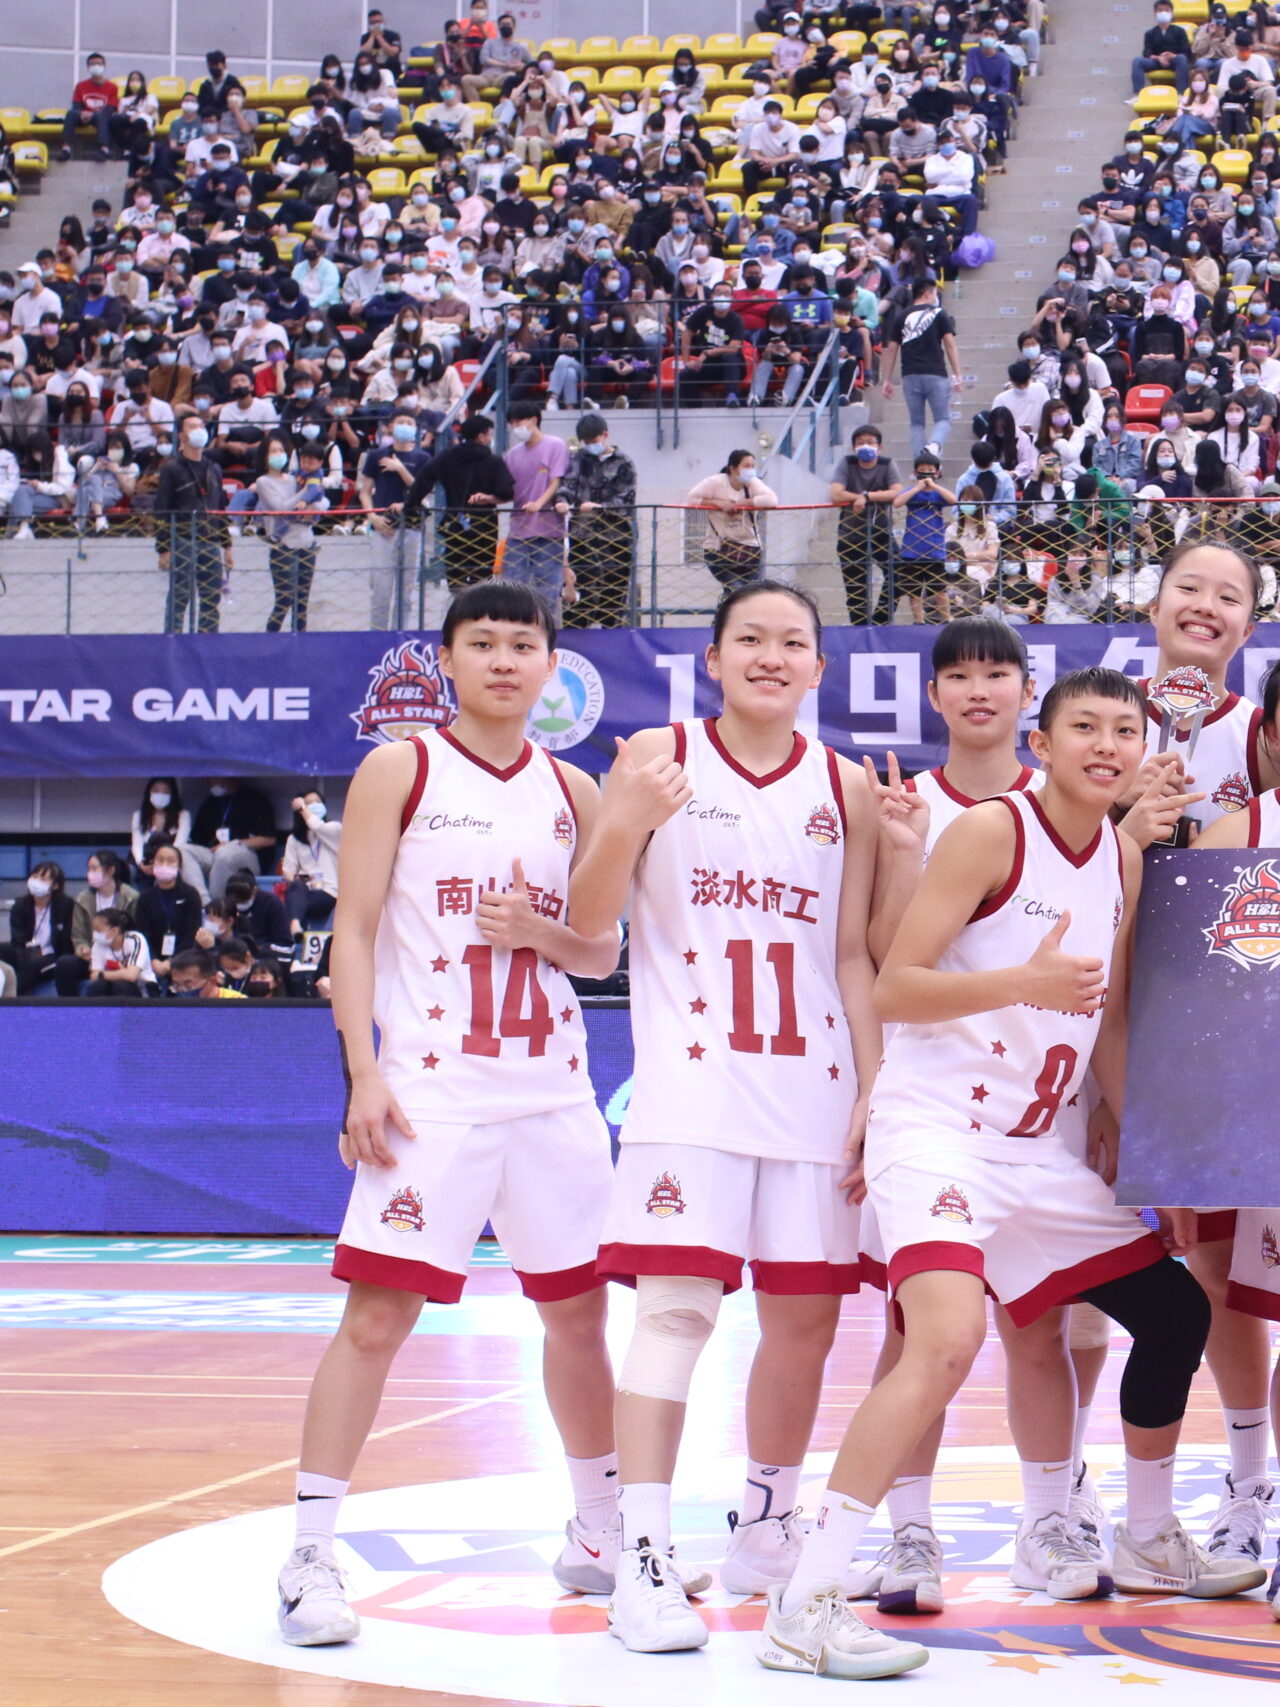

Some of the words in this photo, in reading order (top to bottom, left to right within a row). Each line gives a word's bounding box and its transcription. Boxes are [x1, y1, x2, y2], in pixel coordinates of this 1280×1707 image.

[132, 687, 310, 723] GAME
[1182, 688, 1207, 699] STAR
[370, 708, 401, 721] ALL
[403, 706, 444, 721] STAR
[429, 814, 494, 831] Chatime
[1224, 923, 1256, 937] ALL
[461, 945, 554, 1058] 14
[724, 939, 807, 1057] 11
[1005, 1043, 1078, 1138] 8
